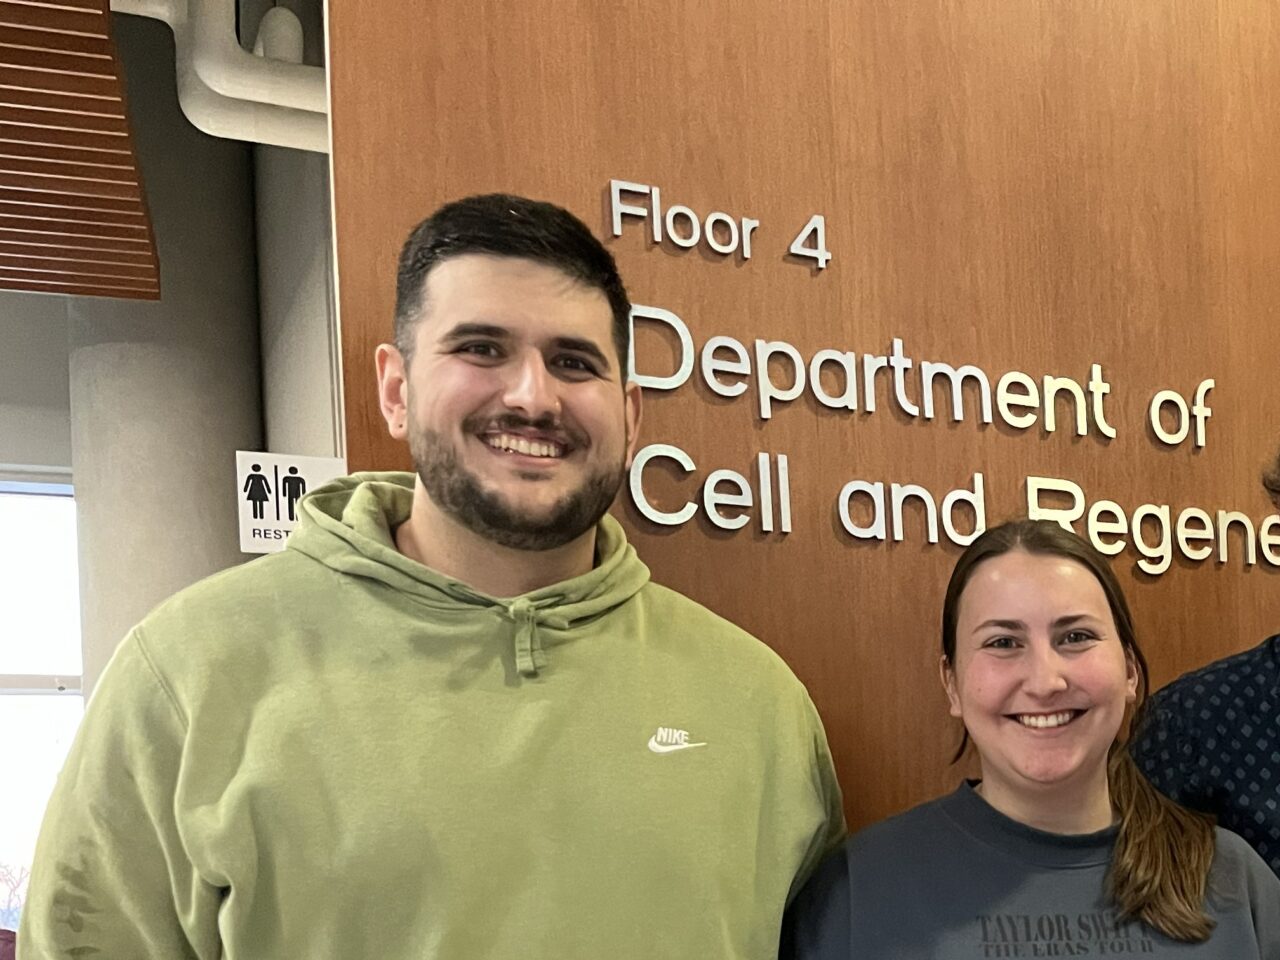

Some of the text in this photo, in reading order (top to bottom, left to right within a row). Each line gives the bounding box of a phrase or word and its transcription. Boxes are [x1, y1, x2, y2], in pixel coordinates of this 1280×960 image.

[610, 179, 832, 269] Floor 4
[628, 304, 1215, 447] Department of
[629, 444, 792, 533] Cell
[838, 473, 985, 547] and
[656, 726, 689, 744] NIKE
[976, 914, 1072, 942] TAYLOR
[978, 942, 1026, 958] THE
[1032, 940, 1089, 957] ERAS
